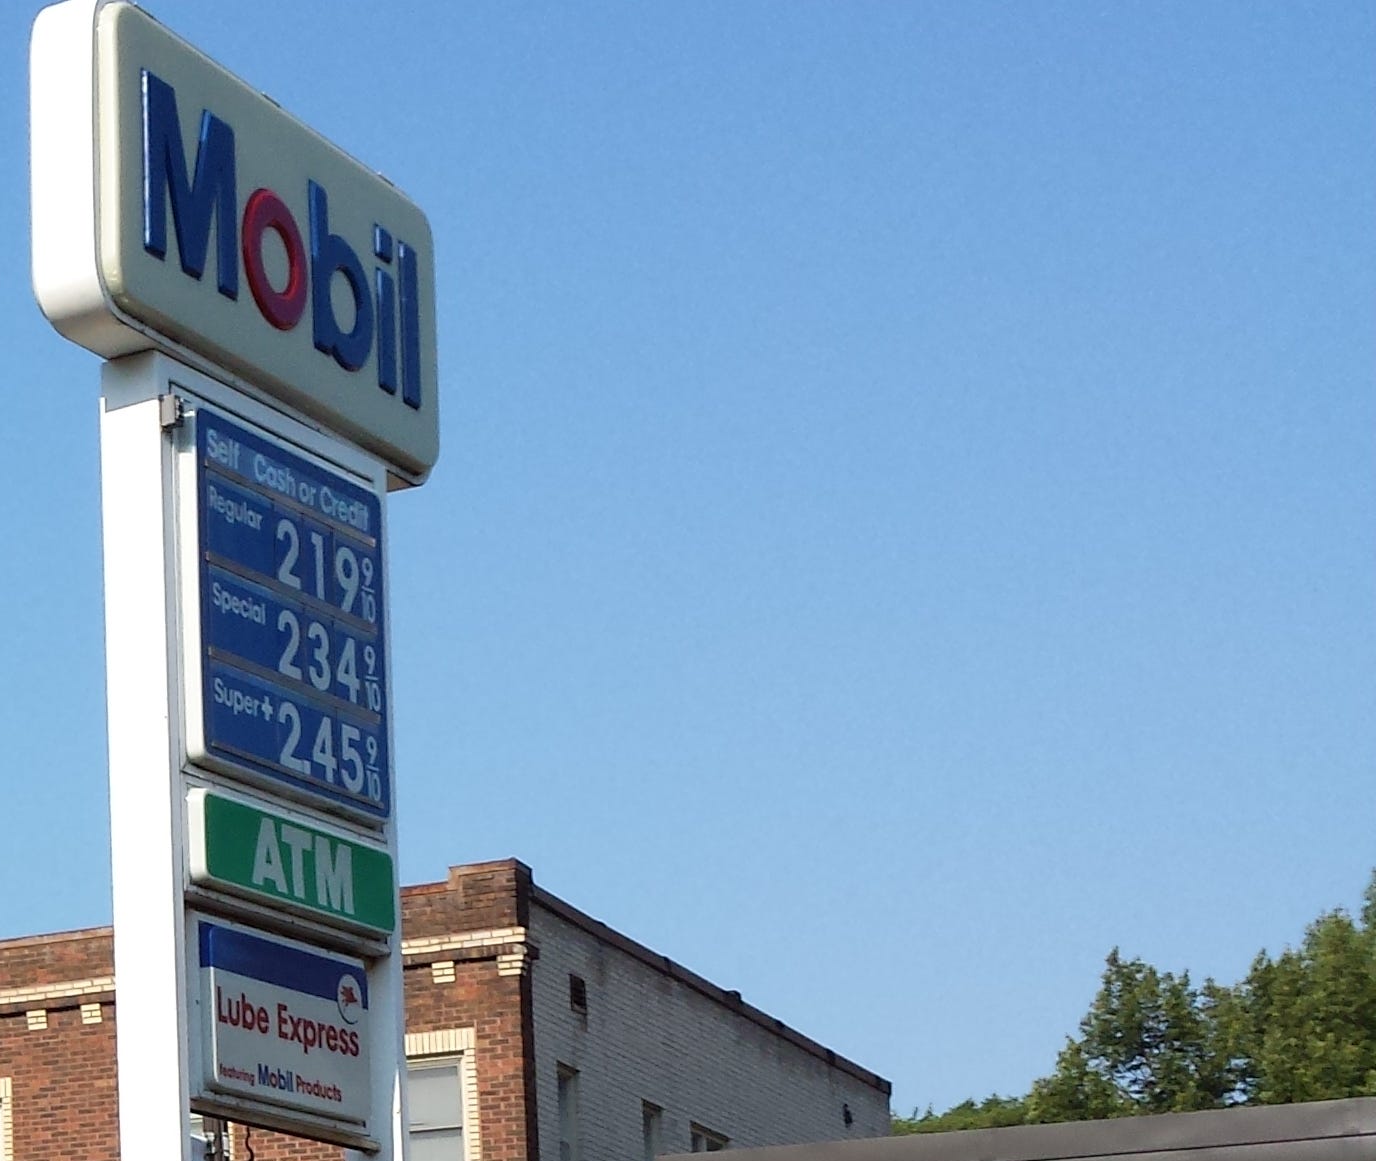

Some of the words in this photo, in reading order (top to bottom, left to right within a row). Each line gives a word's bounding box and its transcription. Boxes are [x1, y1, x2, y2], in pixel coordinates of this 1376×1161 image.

[140, 67, 422, 411] Mobil
[205, 427, 241, 468] Self
[253, 454, 296, 496] Cash
[298, 483, 317, 506] or
[320, 488, 369, 532] Credit
[207, 484, 263, 531] Regular
[212, 582, 266, 626] Special
[252, 818, 355, 915] ATM
[217, 986, 269, 1035] Lube
[277, 1003, 360, 1057] Express
[219, 1064, 255, 1086] featuring
[257, 1063, 294, 1092] Mobil
[296, 1074, 342, 1102] Products
